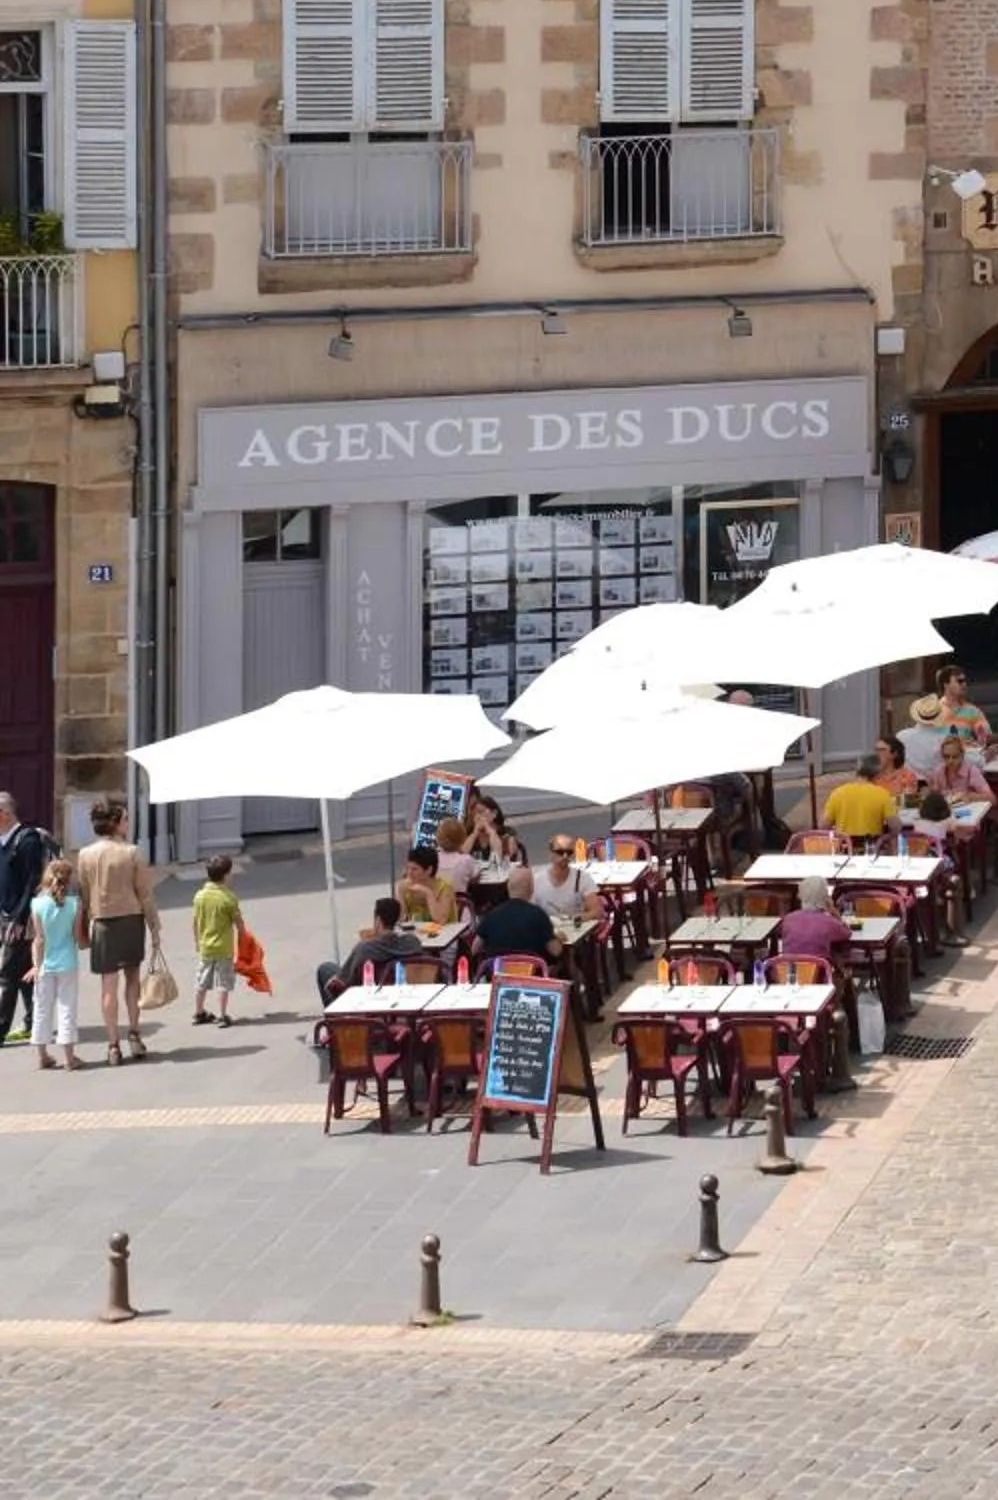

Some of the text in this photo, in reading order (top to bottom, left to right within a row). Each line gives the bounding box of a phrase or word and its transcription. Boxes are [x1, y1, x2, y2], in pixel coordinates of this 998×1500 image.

[238, 400, 831, 468] AGENCE DES DUCS
[91, 567, 111, 581] 21
[357, 569, 371, 662] ACHAT
